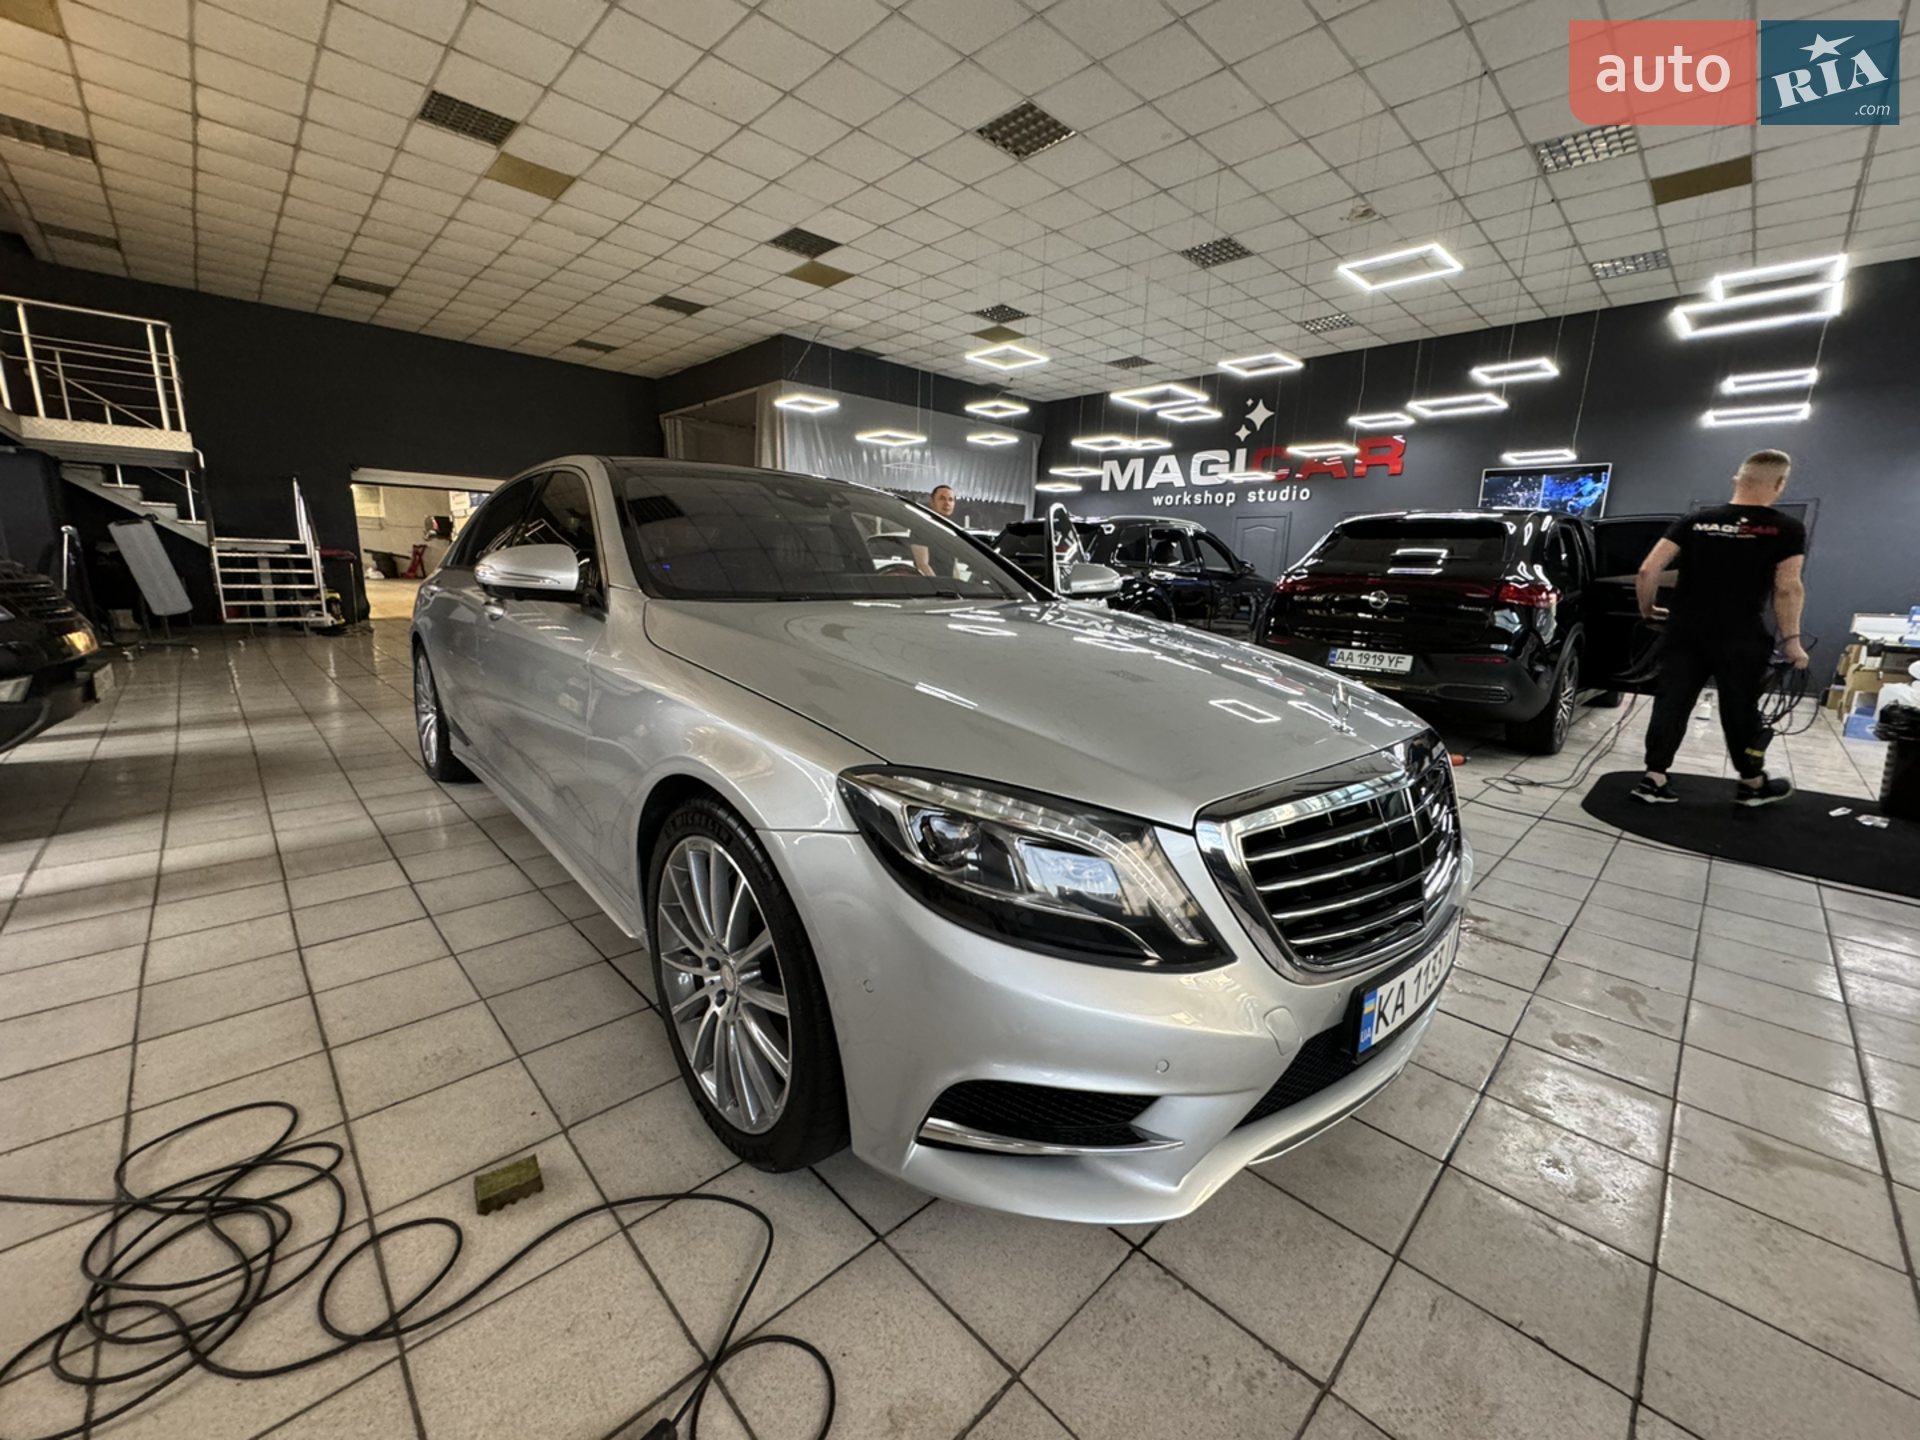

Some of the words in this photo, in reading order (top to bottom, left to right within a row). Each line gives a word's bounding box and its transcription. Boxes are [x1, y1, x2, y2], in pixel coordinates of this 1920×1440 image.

[1101, 435, 1406, 491] MAGICAR
[1152, 490, 1236, 507] workshop
[1247, 486, 1311, 503] studio
[1336, 650, 1354, 663] AA
[1357, 652, 1385, 667] 1919
[1387, 655, 1406, 668] YF
[1375, 979, 1406, 1036] KA
